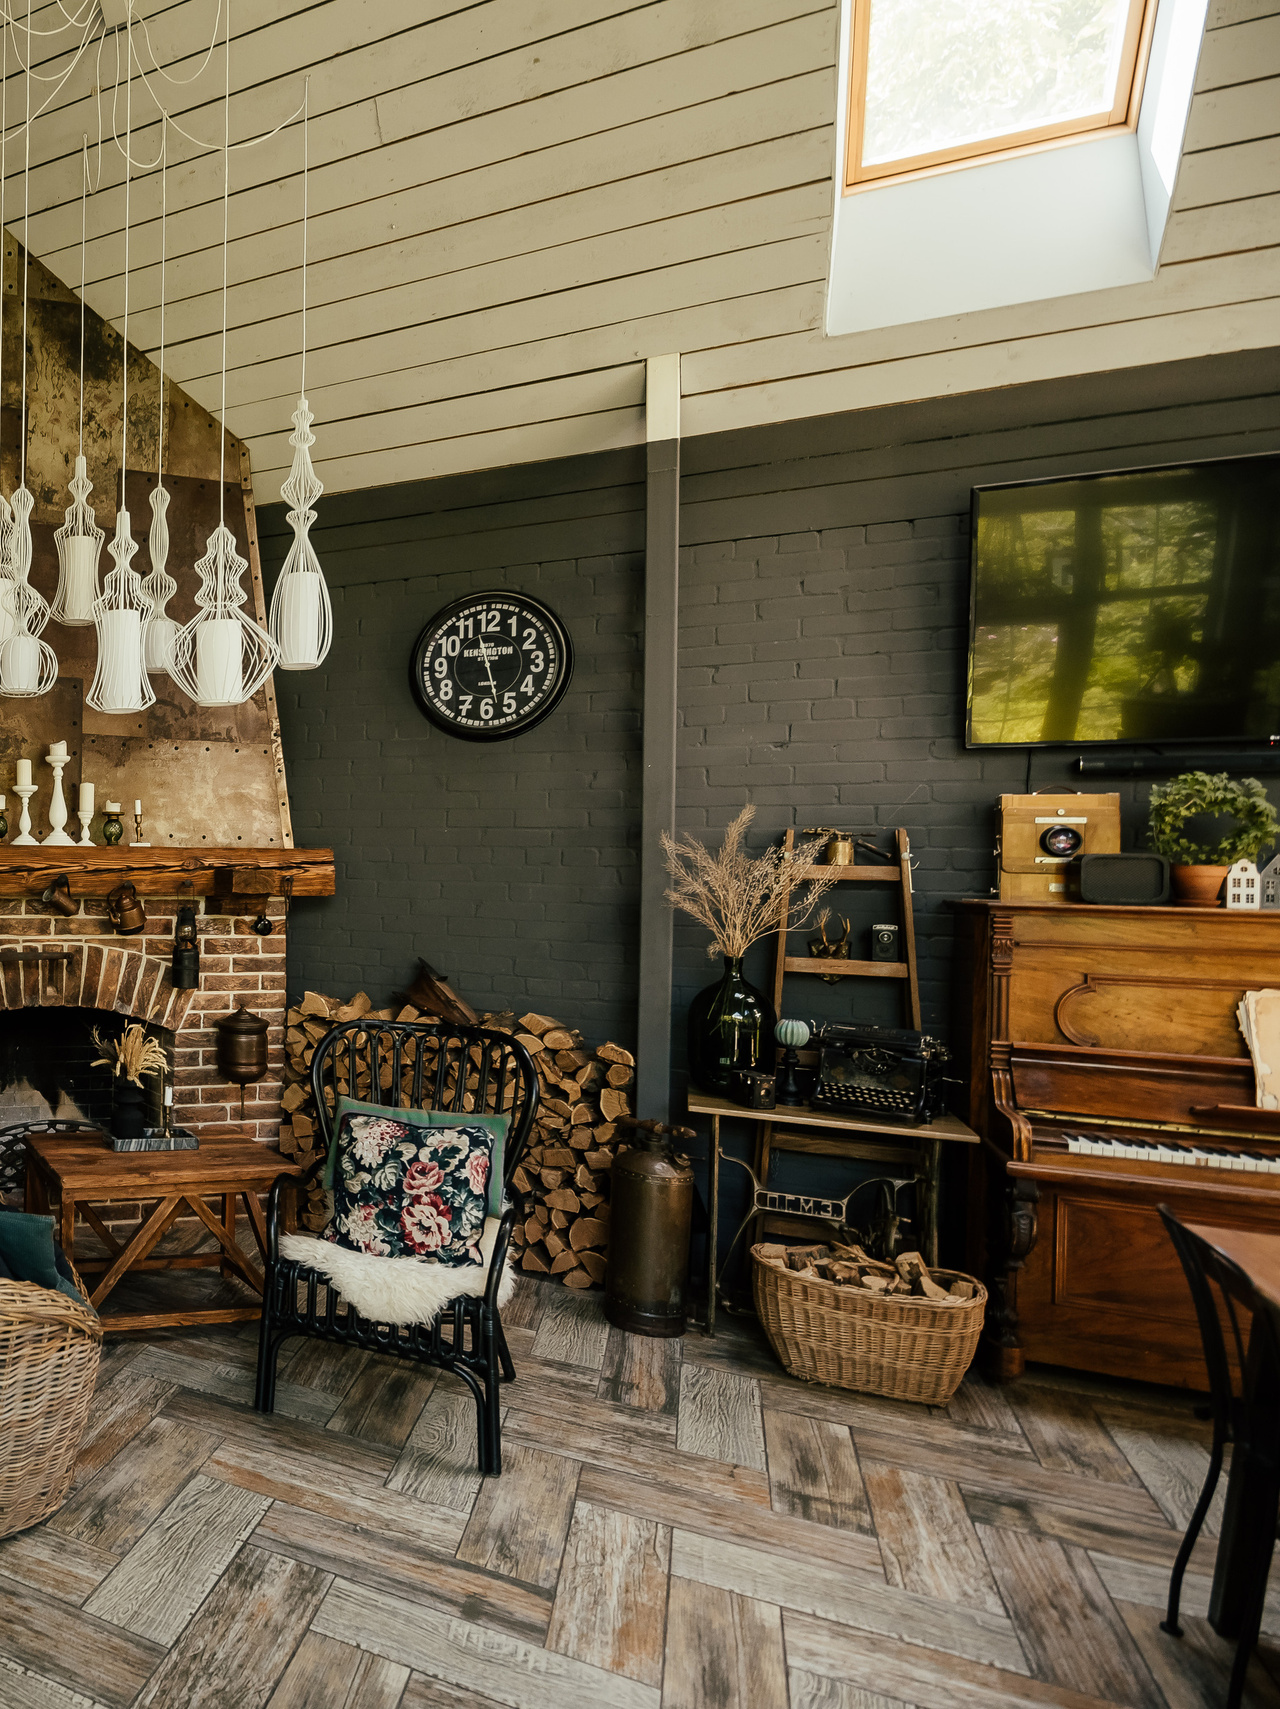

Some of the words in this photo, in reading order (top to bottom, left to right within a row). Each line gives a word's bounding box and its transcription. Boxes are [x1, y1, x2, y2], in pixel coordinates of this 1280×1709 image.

[456, 618, 473, 639] 11
[477, 611, 501, 632] 12
[508, 616, 517, 637] 1
[438, 635, 460, 657] 10
[522, 628, 537, 650] 2
[434, 658, 448, 678] 9
[530, 651, 544, 672] 3
[440, 680, 453, 700] 8
[520, 675, 534, 696] 4
[459, 695, 472, 716] 7
[480, 698, 493, 719] 6
[502, 692, 516, 713] 5
